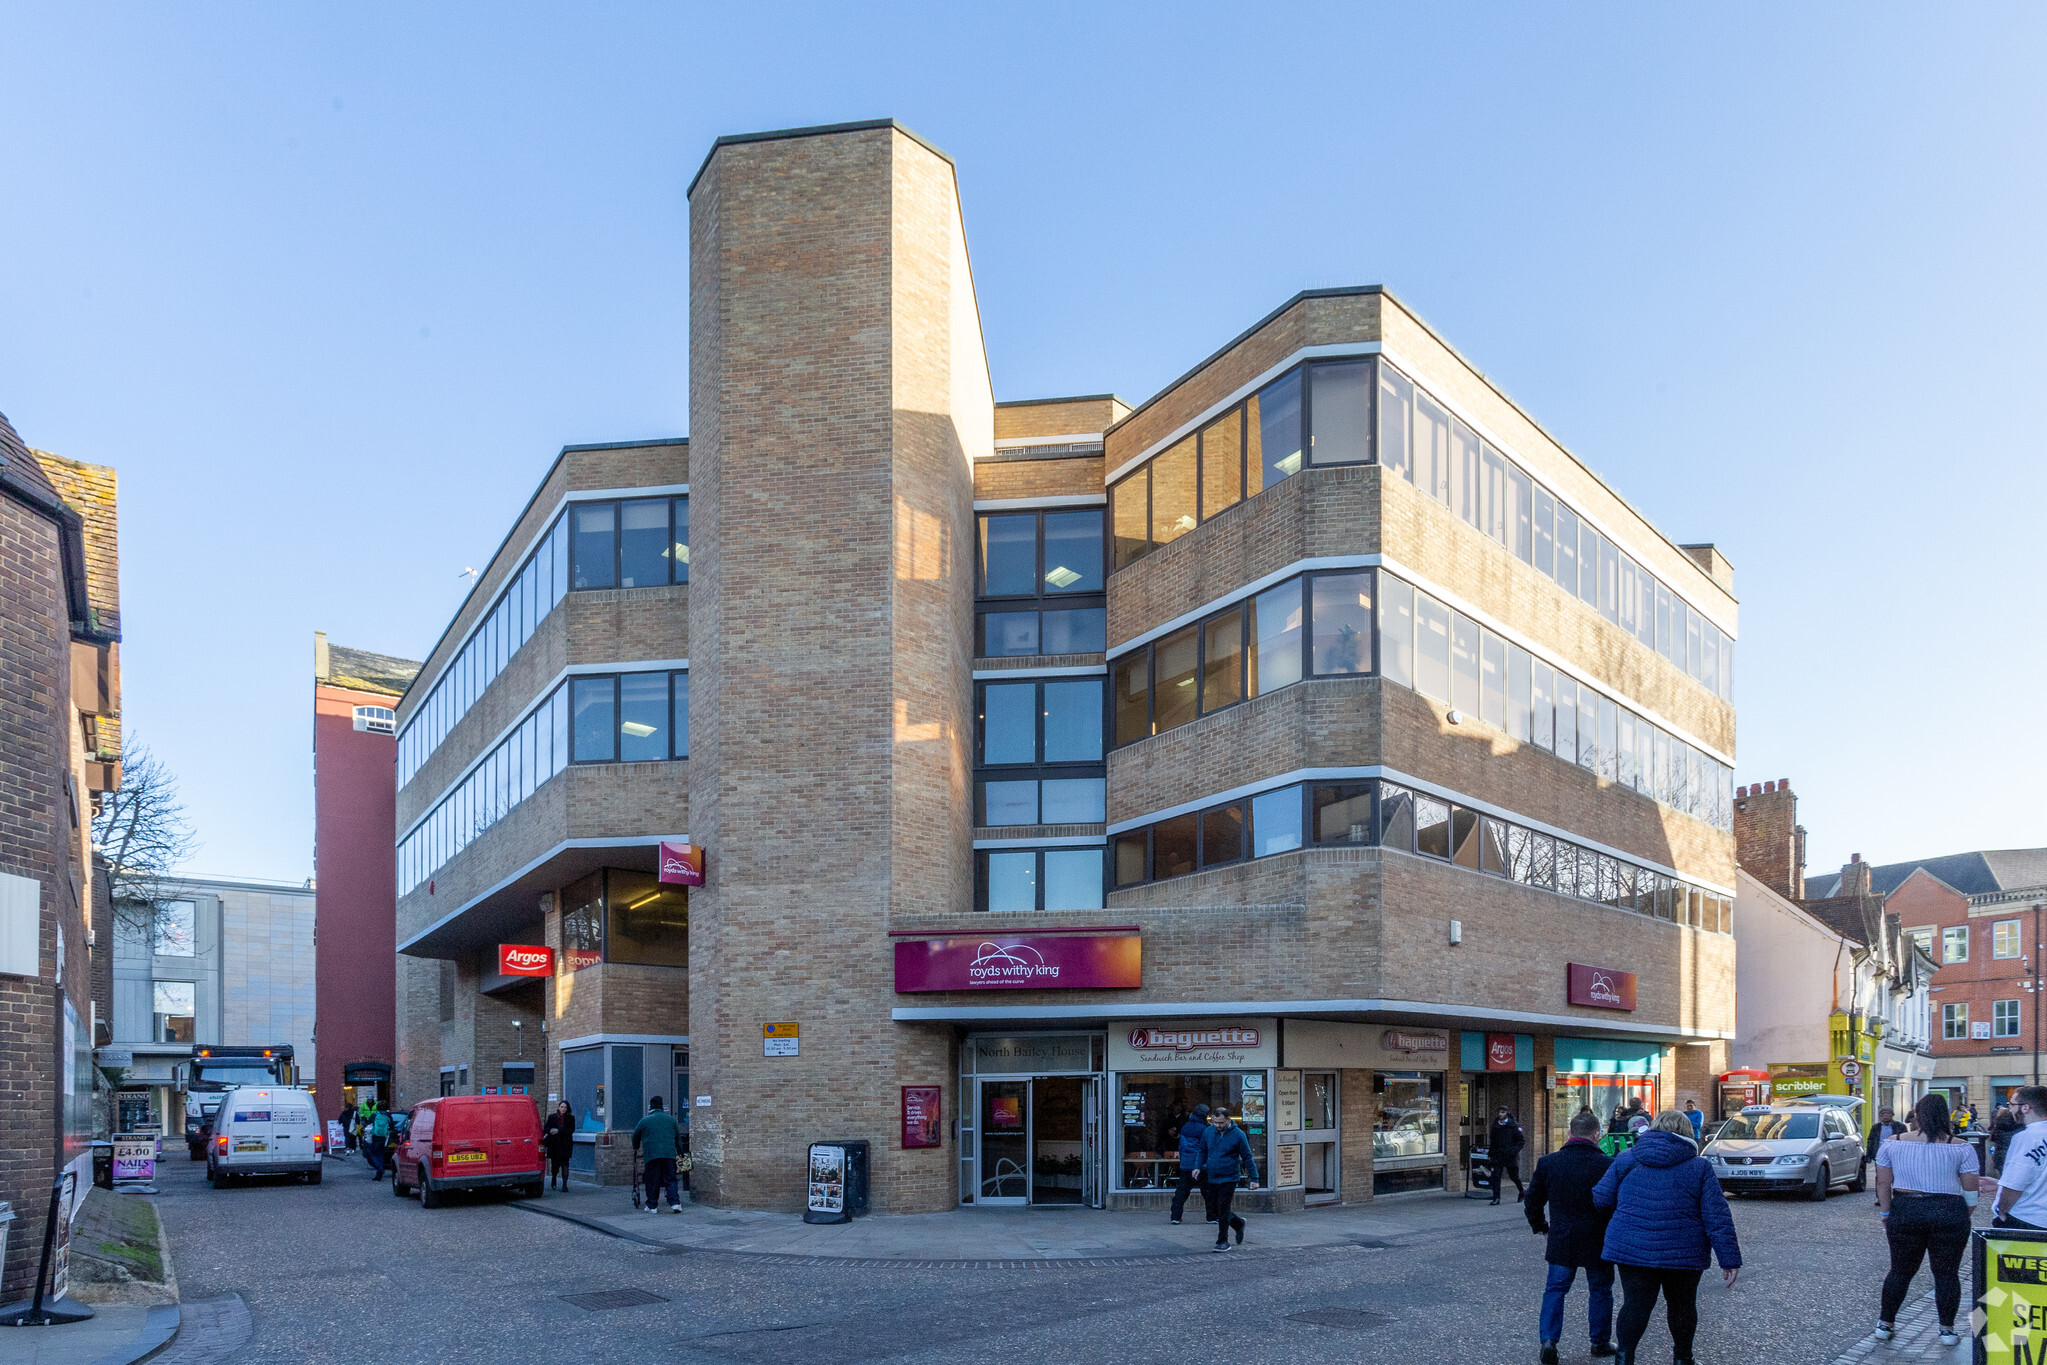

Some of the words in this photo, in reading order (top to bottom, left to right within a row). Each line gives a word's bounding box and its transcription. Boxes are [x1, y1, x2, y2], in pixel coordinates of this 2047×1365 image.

[506, 950, 547, 965] Argos
[970, 964, 1000, 978] royds
[1002, 964, 1034, 977] withy
[1035, 964, 1060, 977] king
[1591, 991, 1601, 1000] royds
[1602, 992, 1611, 1002] withy
[1612, 993, 1620, 1004] king
[1132, 1029, 1143, 1046] la
[1150, 1029, 1256, 1047] baguette
[1400, 1036, 1446, 1049] baguette
[979, 1047, 1009, 1057] North
[1014, 1047, 1046, 1058] Bailey
[1051, 1046, 1086, 1056] House
[1491, 1042, 1512, 1058] Argos
[1140, 1053, 1172, 1062] Sandwich
[1175, 1053, 1186, 1061] Bar
[1189, 1053, 1201, 1061] and
[1204, 1052, 1225, 1062] Coffee
[1227, 1051, 1245, 1063] Shop
[1776, 1081, 1826, 1091] scribbler
